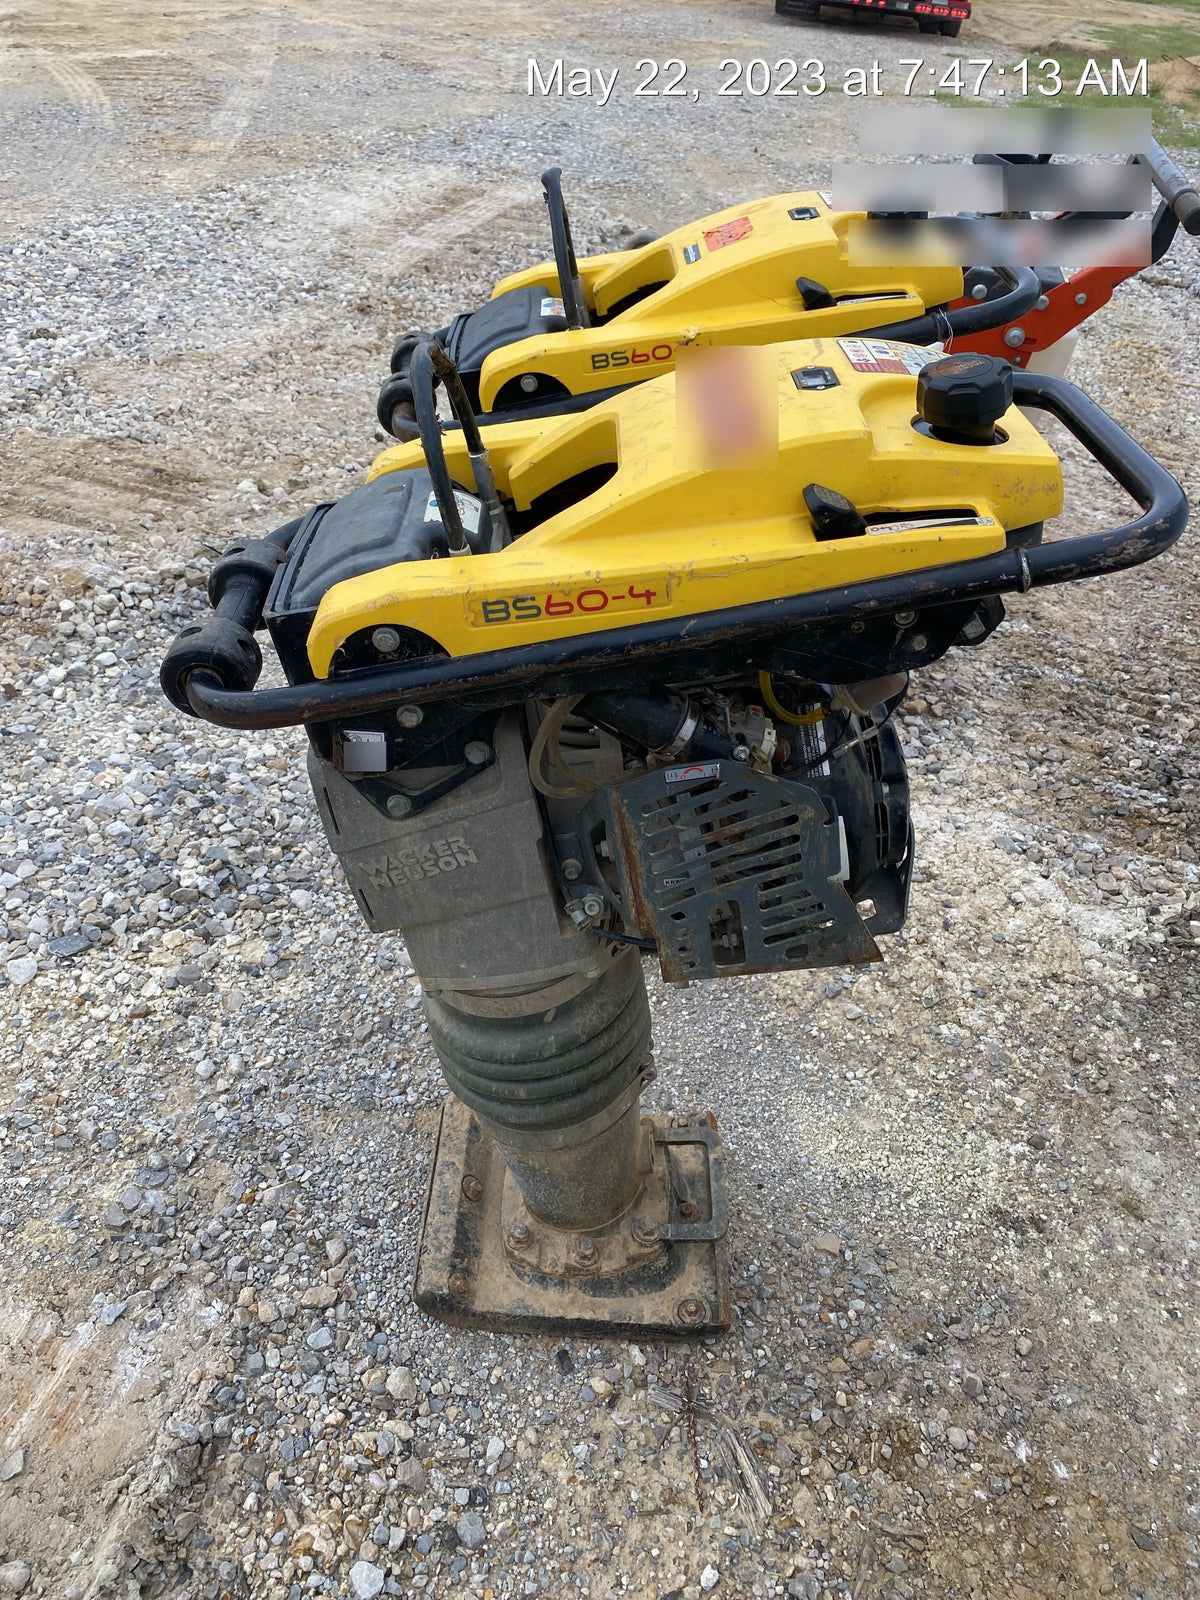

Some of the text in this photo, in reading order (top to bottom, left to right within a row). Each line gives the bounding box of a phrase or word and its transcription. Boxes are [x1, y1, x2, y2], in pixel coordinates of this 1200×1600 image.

[482, 585, 656, 623] BS60-4
[358, 836, 471, 876] WACKER
[369, 849, 479, 891] NEUSON
